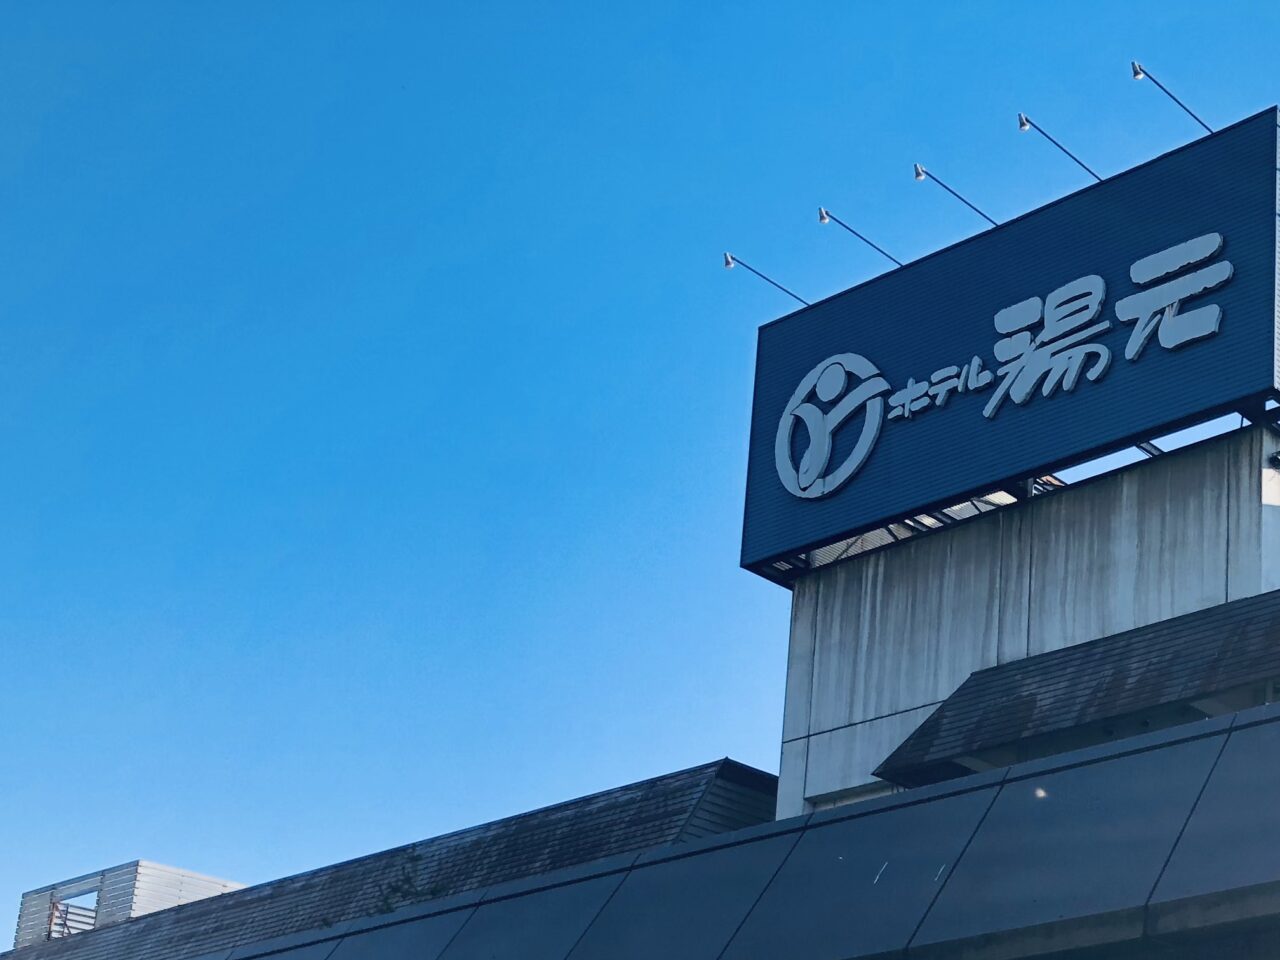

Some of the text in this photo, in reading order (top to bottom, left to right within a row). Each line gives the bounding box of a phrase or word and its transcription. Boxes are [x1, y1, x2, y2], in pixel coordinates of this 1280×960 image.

[887, 232, 1234, 419] ホテル湯元
